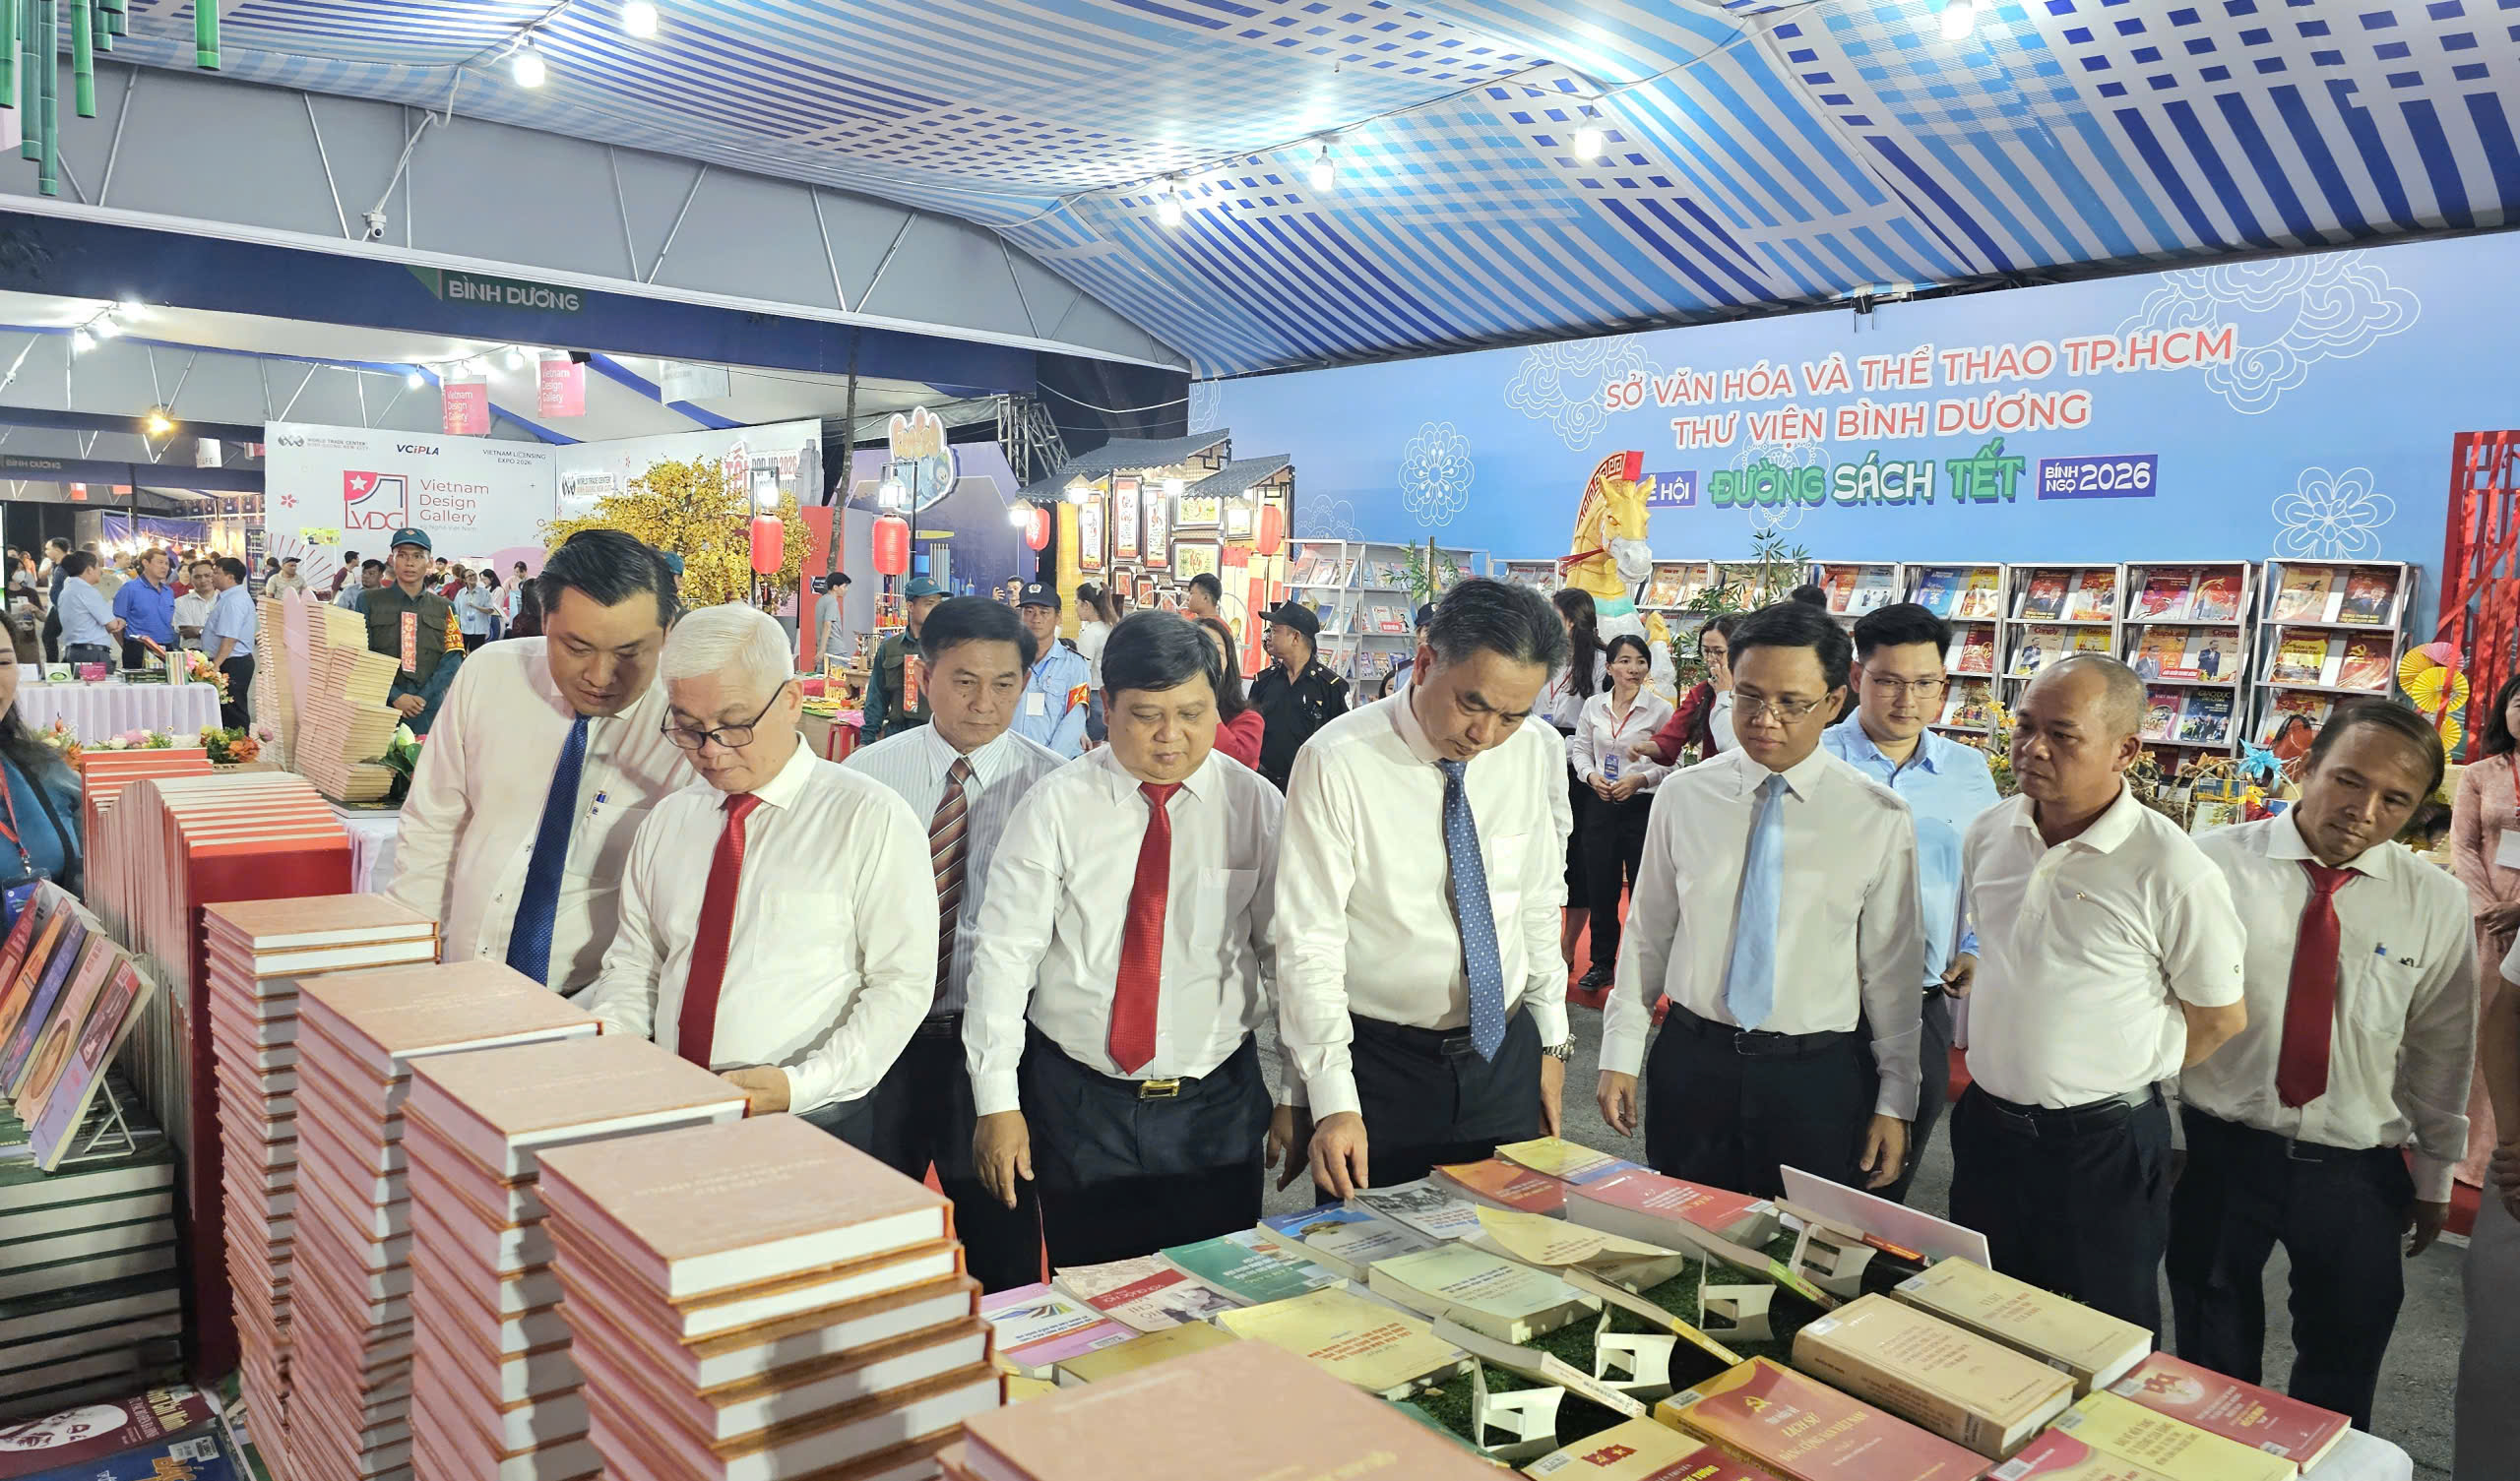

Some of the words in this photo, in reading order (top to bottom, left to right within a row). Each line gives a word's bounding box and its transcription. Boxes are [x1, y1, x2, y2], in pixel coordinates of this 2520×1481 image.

[448, 275, 502, 303] BÌNH
[506, 285, 580, 311] DƯƠNG
[1606, 372, 1645, 410] SỞ
[1653, 368, 1715, 405] VĂN
[1724, 362, 1794, 401] HÓA
[1803, 355, 1851, 393] VÀ
[1859, 344, 1930, 387] THỂ
[1941, 344, 2052, 383] THAO
[2063, 327, 2235, 373] TP.HCM
[1672, 411, 1739, 448] THƯ
[1748, 405, 1824, 449] VIỆN
[1837, 401, 1925, 439] BÌNH
[1937, 391, 2088, 434] DƯƠNG
[482, 449, 513, 458] VIETNAM
[513, 452, 546, 461] LICENSING
[1708, 457, 1827, 506] ĐƯỜNG
[1832, 449, 1935, 503] SÁCH
[1944, 436, 2026, 501] TẾT
[2045, 463, 2079, 480] BÍNH
[2078, 461, 2152, 491] 2026
[419, 478, 489, 495] Vietnam
[1661, 476, 1690, 504] HỘI
[2046, 478, 2077, 494] NGỌ
[419, 494, 476, 510] Design
[419, 509, 476, 526] Gallery
